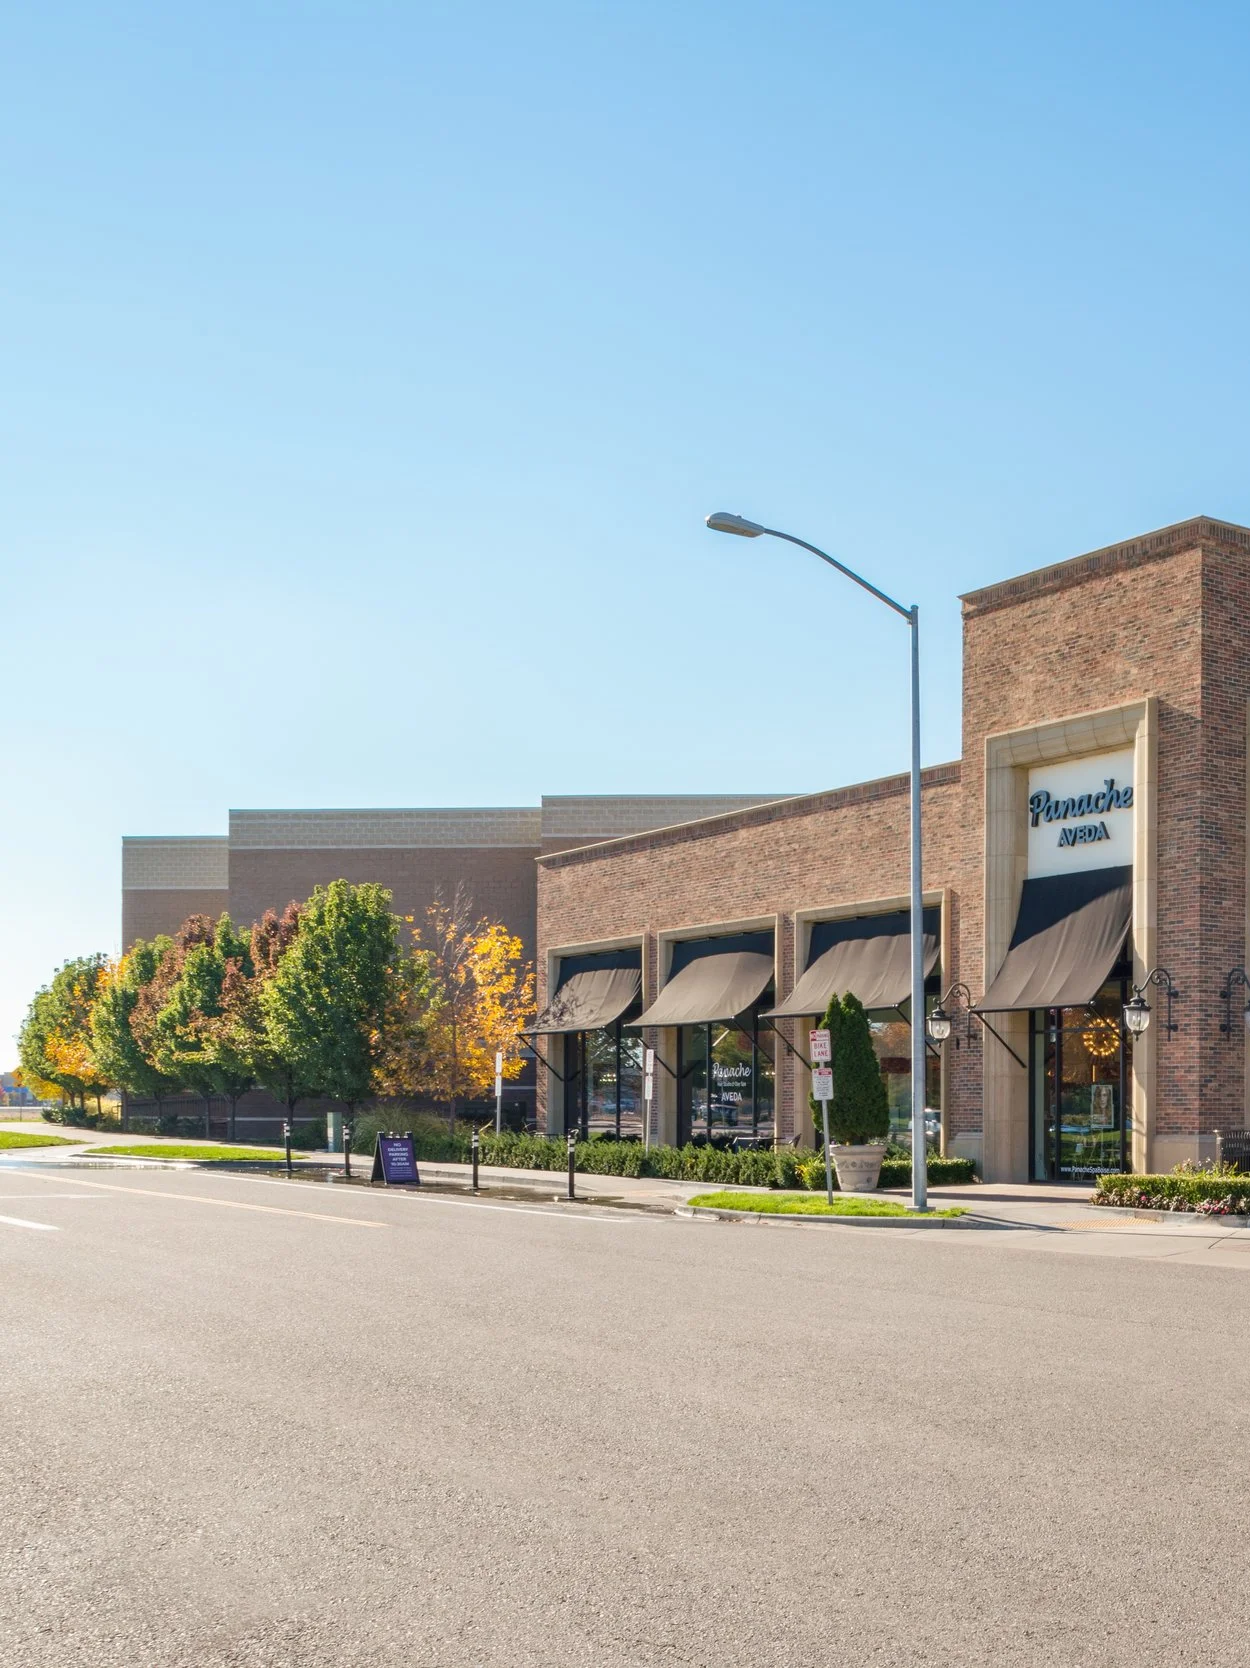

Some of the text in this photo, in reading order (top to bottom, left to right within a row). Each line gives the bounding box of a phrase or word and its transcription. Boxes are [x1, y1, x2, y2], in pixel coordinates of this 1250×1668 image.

[1029, 778, 1134, 828] Panache
[1057, 821, 1111, 847] AVEDA
[712, 1062, 752, 1078] Panache
[721, 1092, 742, 1101] AVEDA
